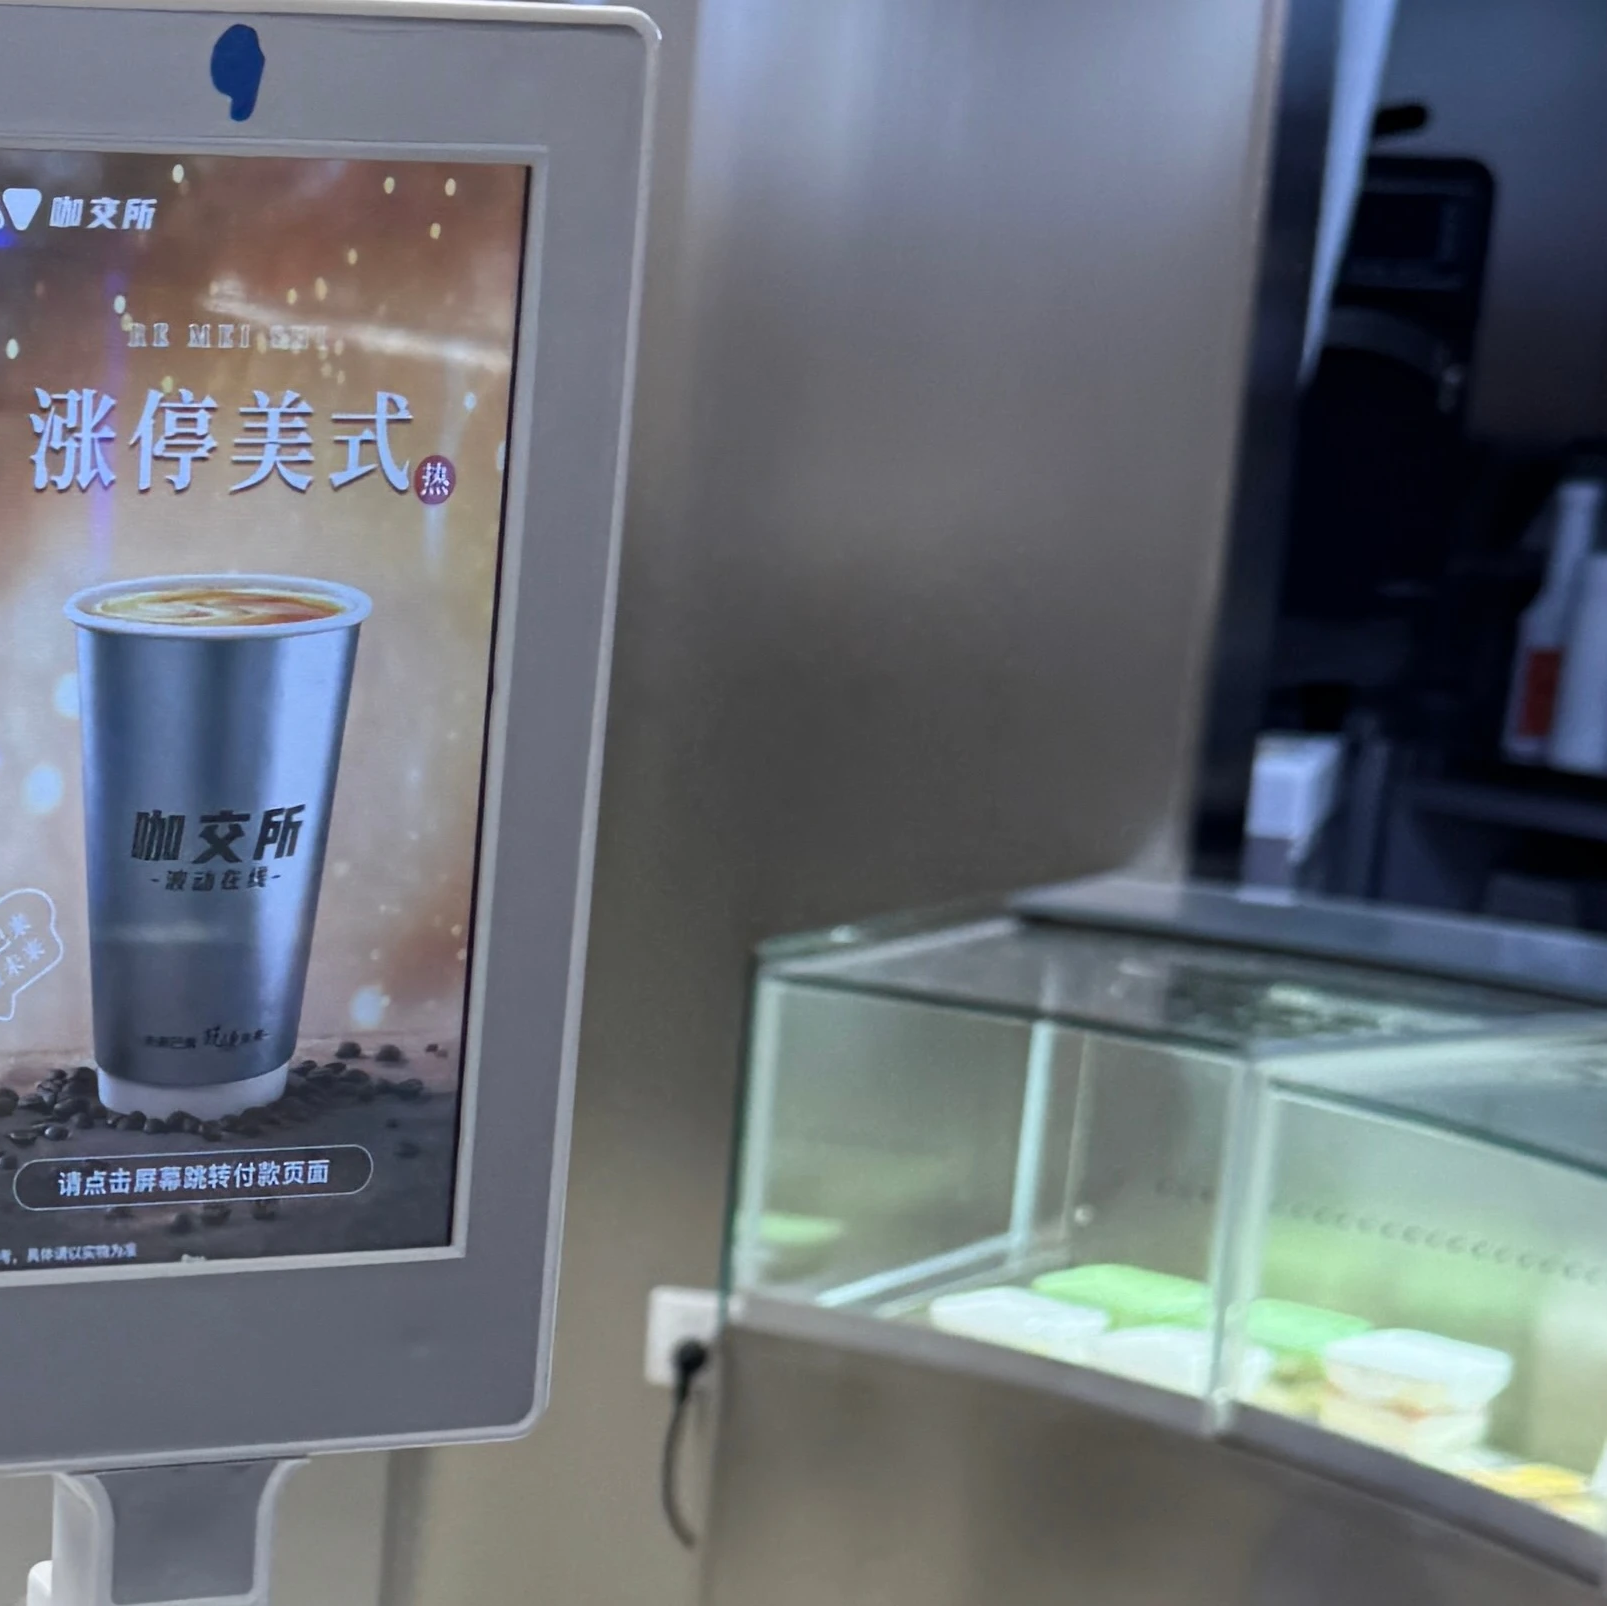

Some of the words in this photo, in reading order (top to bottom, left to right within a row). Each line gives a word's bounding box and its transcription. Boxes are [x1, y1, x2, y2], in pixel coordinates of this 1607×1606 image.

[49, 196, 158, 231] 咖交所
[187, 322, 251, 349] MEI
[29, 387, 414, 495] 涨停美式
[420, 461, 451, 497] 热
[131, 804, 306, 865] 咖交所
[57, 1159, 331, 1197] 请点击屏幕跳转付款页面
